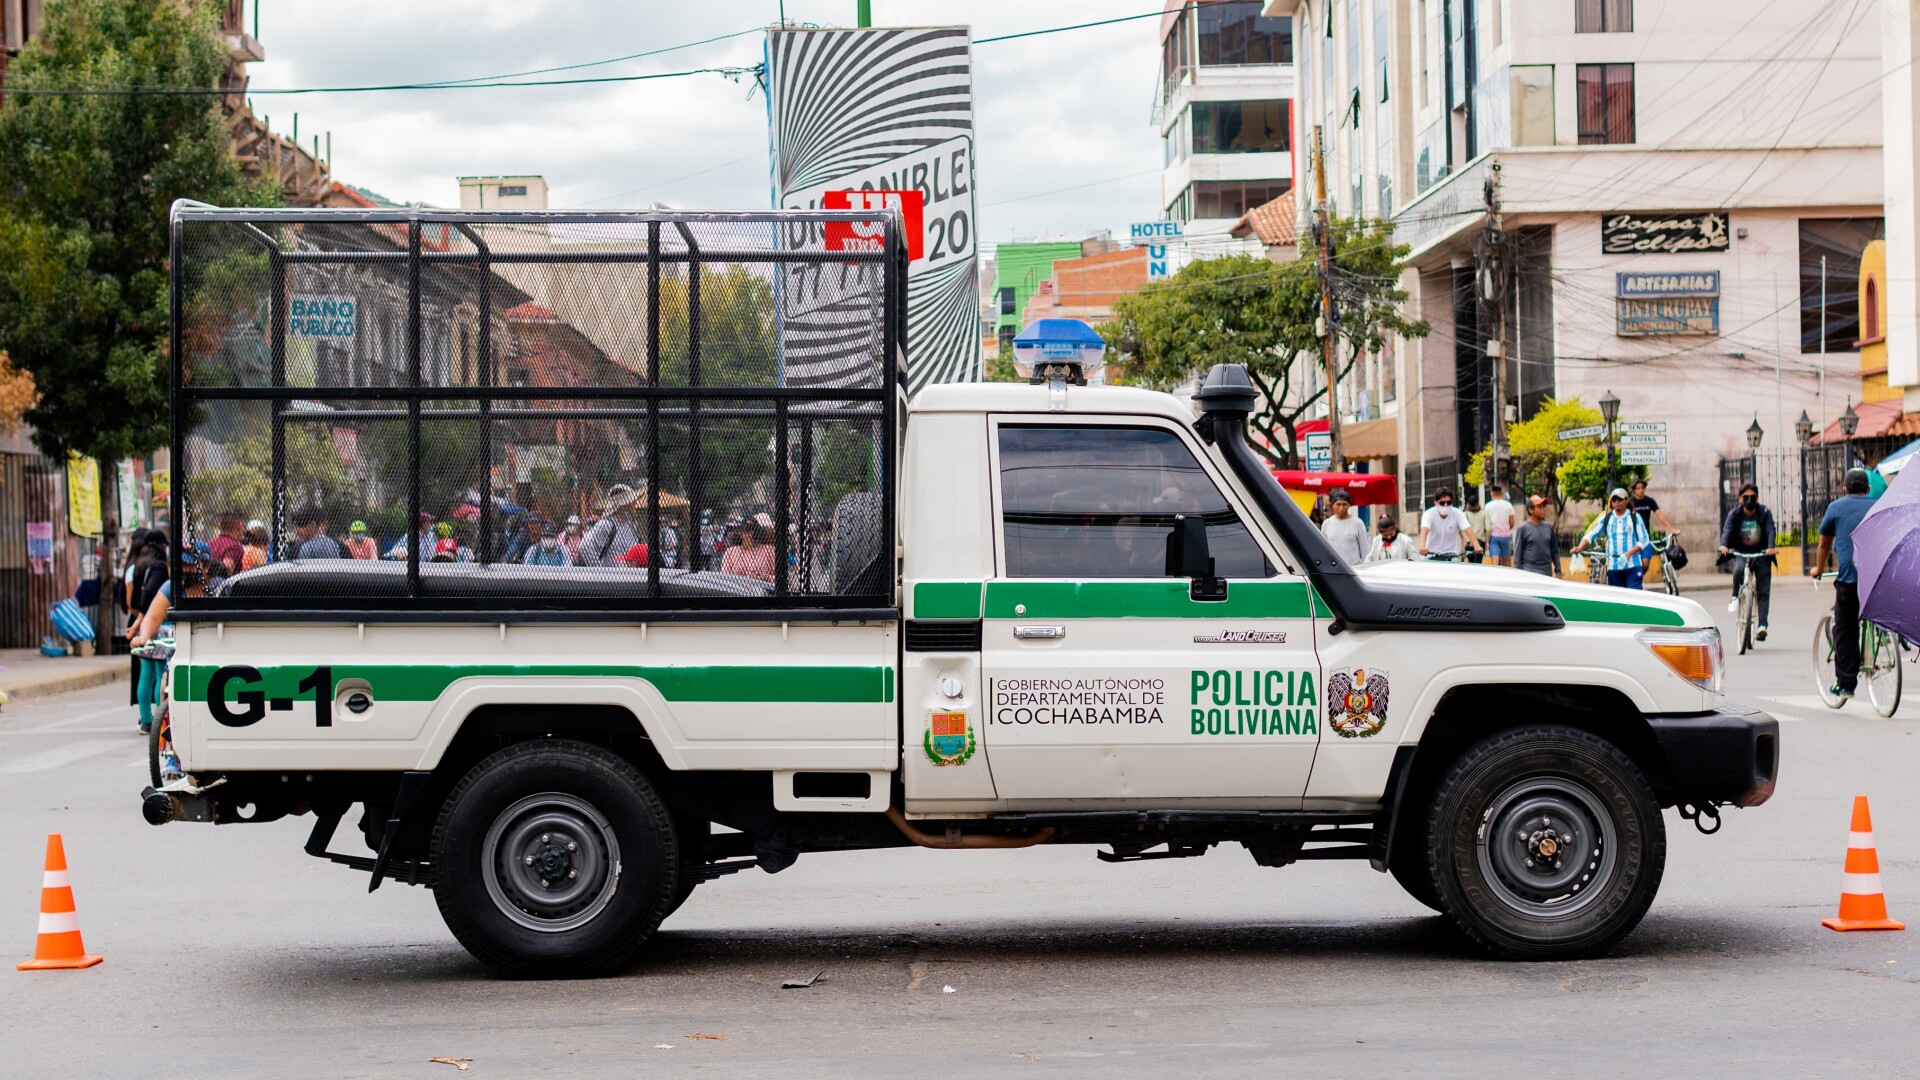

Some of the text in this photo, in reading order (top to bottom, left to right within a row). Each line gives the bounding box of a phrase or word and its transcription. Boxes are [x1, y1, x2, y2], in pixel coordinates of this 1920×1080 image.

[1131, 222, 1182, 237] HOTEL
[1604, 214, 1697, 235] Joyas
[928, 210, 969, 262] 20
[1605, 234, 1729, 253] Eclipse
[1625, 276, 1714, 291] ARTESANIAS
[1625, 299, 1660, 318] INTI
[1387, 604, 1471, 620] LAND CRUISER
[997, 677, 1164, 690] GOBIERNO AUTÓNOMO
[1191, 670, 1317, 707] POLICIA
[207, 665, 332, 727] G-1
[997, 692, 1164, 706] DEPARTAMENTAL DE
[997, 707, 1164, 725] COCHABAMBA
[1191, 708, 1317, 736] BOLIVIANA
